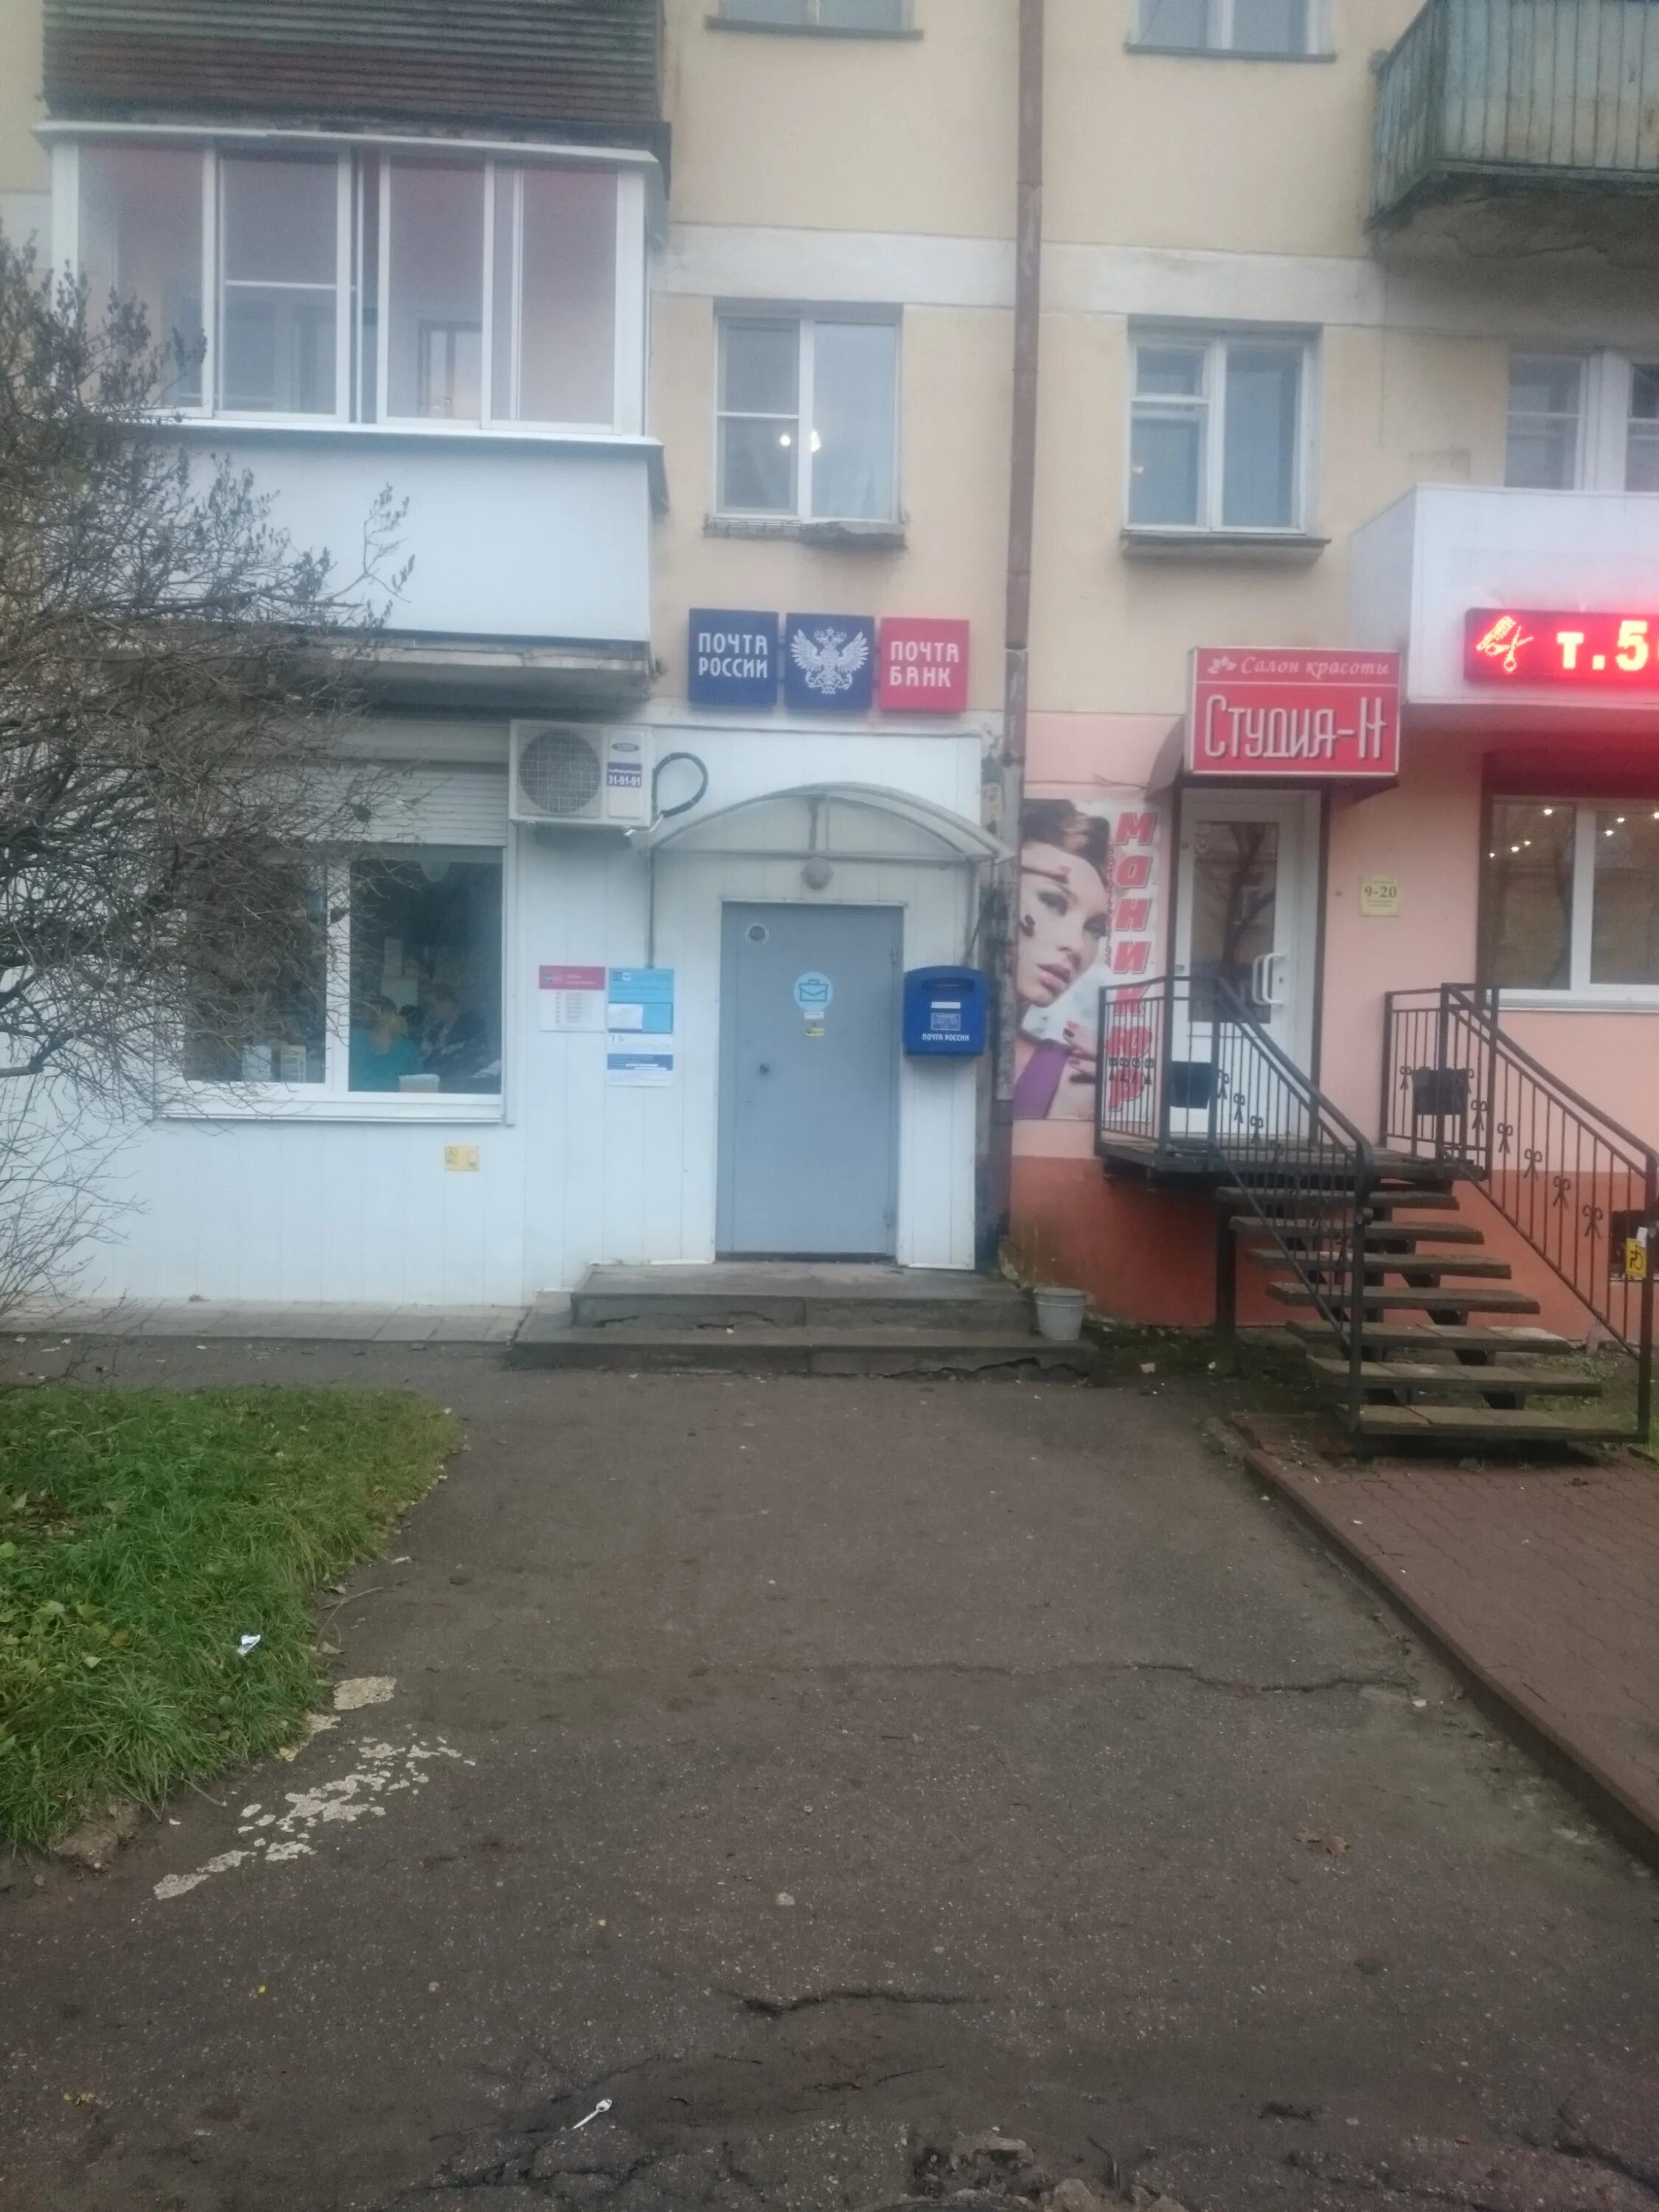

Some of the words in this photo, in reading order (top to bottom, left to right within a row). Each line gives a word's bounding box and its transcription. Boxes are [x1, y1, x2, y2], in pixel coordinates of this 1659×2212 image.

[698, 632, 768, 655] ПОЧТА
[890, 641, 959, 663] ПОЧТА
[1557, 619, 1659, 671] т.5
[698, 657, 768, 679] РОССИИ
[889, 667, 951, 688] БАНК
[1240, 655, 1299, 673] Салон
[1305, 658, 1389, 680] красоты
[1365, 886, 1397, 897] 9-20
[922, 1033, 943, 1041] ПОЧТА
